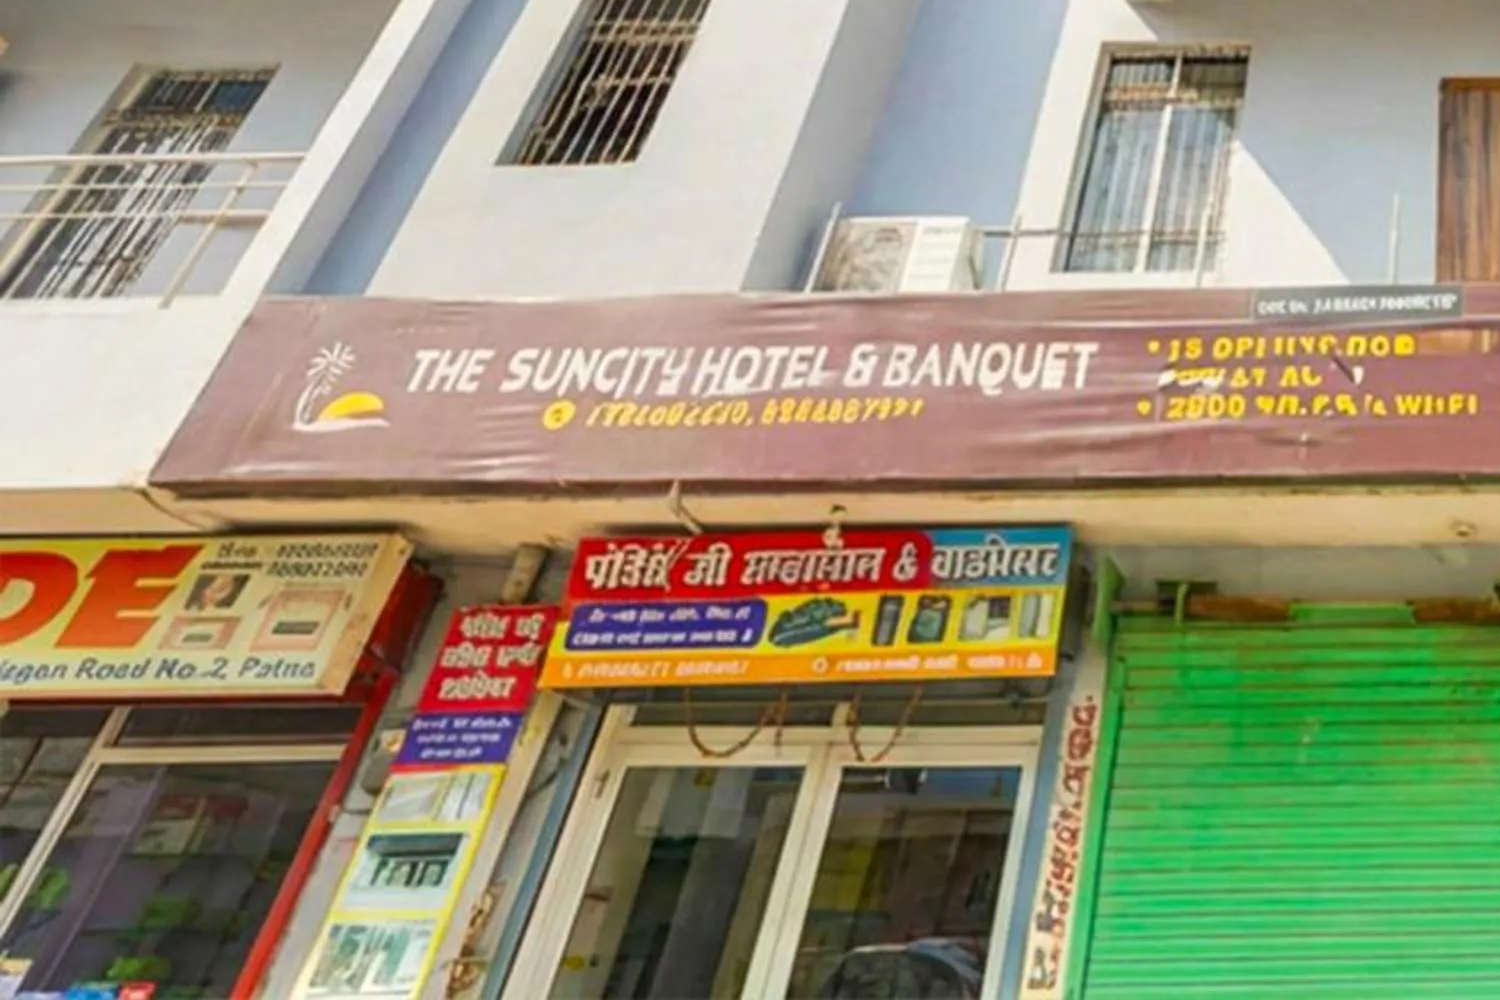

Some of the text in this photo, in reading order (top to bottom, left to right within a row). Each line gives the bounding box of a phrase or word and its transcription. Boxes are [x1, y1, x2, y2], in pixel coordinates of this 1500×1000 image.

[406, 340, 1100, 400] THE SUNCITY HOTEL & BANQUET
